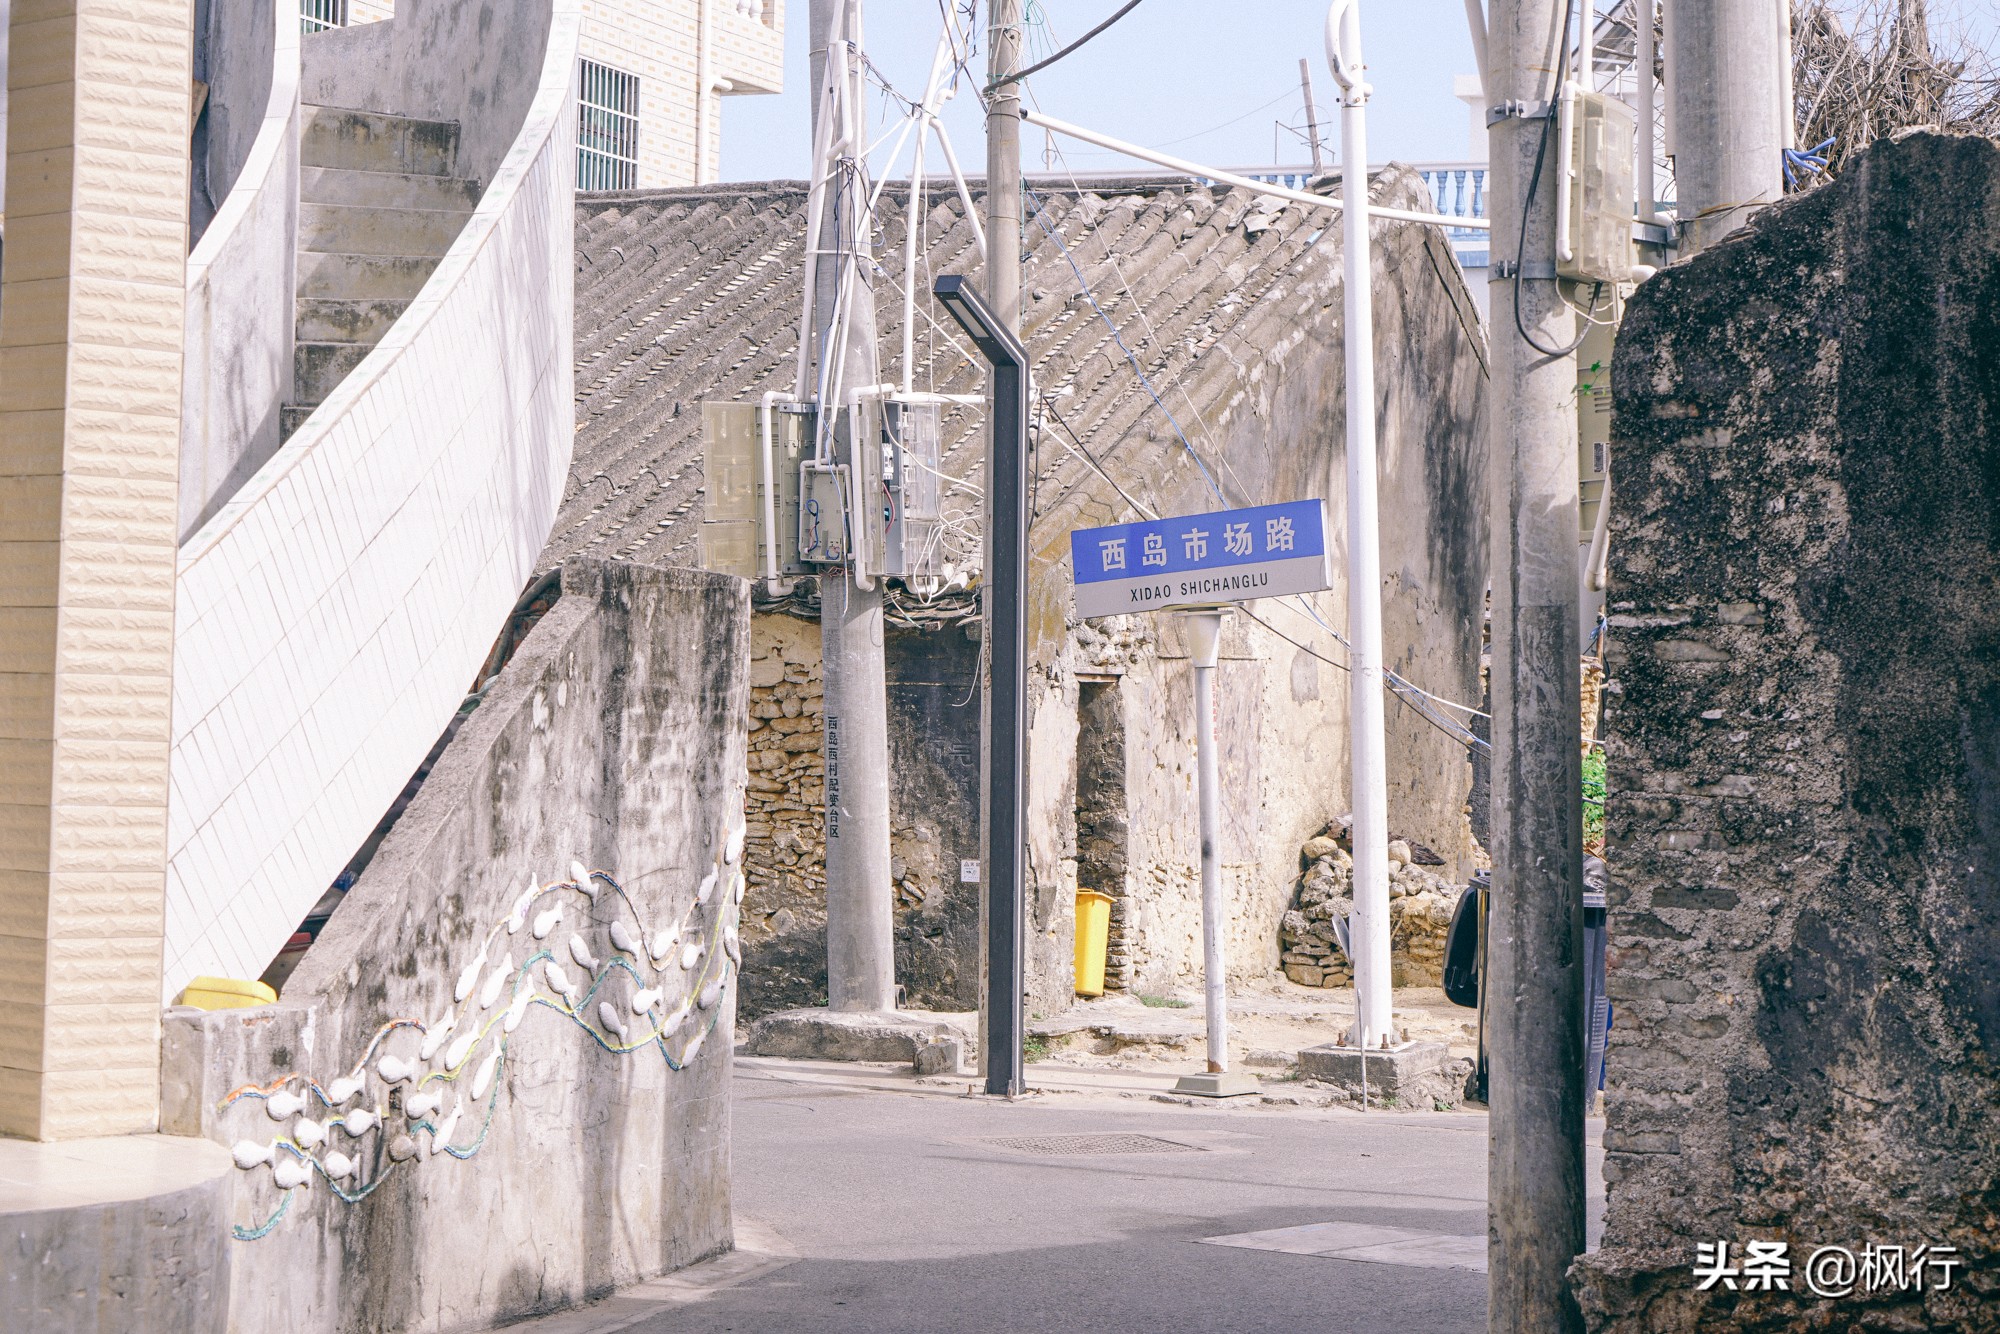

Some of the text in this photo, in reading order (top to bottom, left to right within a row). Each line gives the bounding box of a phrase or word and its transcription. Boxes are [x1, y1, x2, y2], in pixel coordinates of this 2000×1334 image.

[1098, 516, 1296, 572] 西岛市场路
[1130, 572, 1269, 602] XIDAO SHICHANGLU
[827, 716, 840, 838] 西岛西村配变台区
